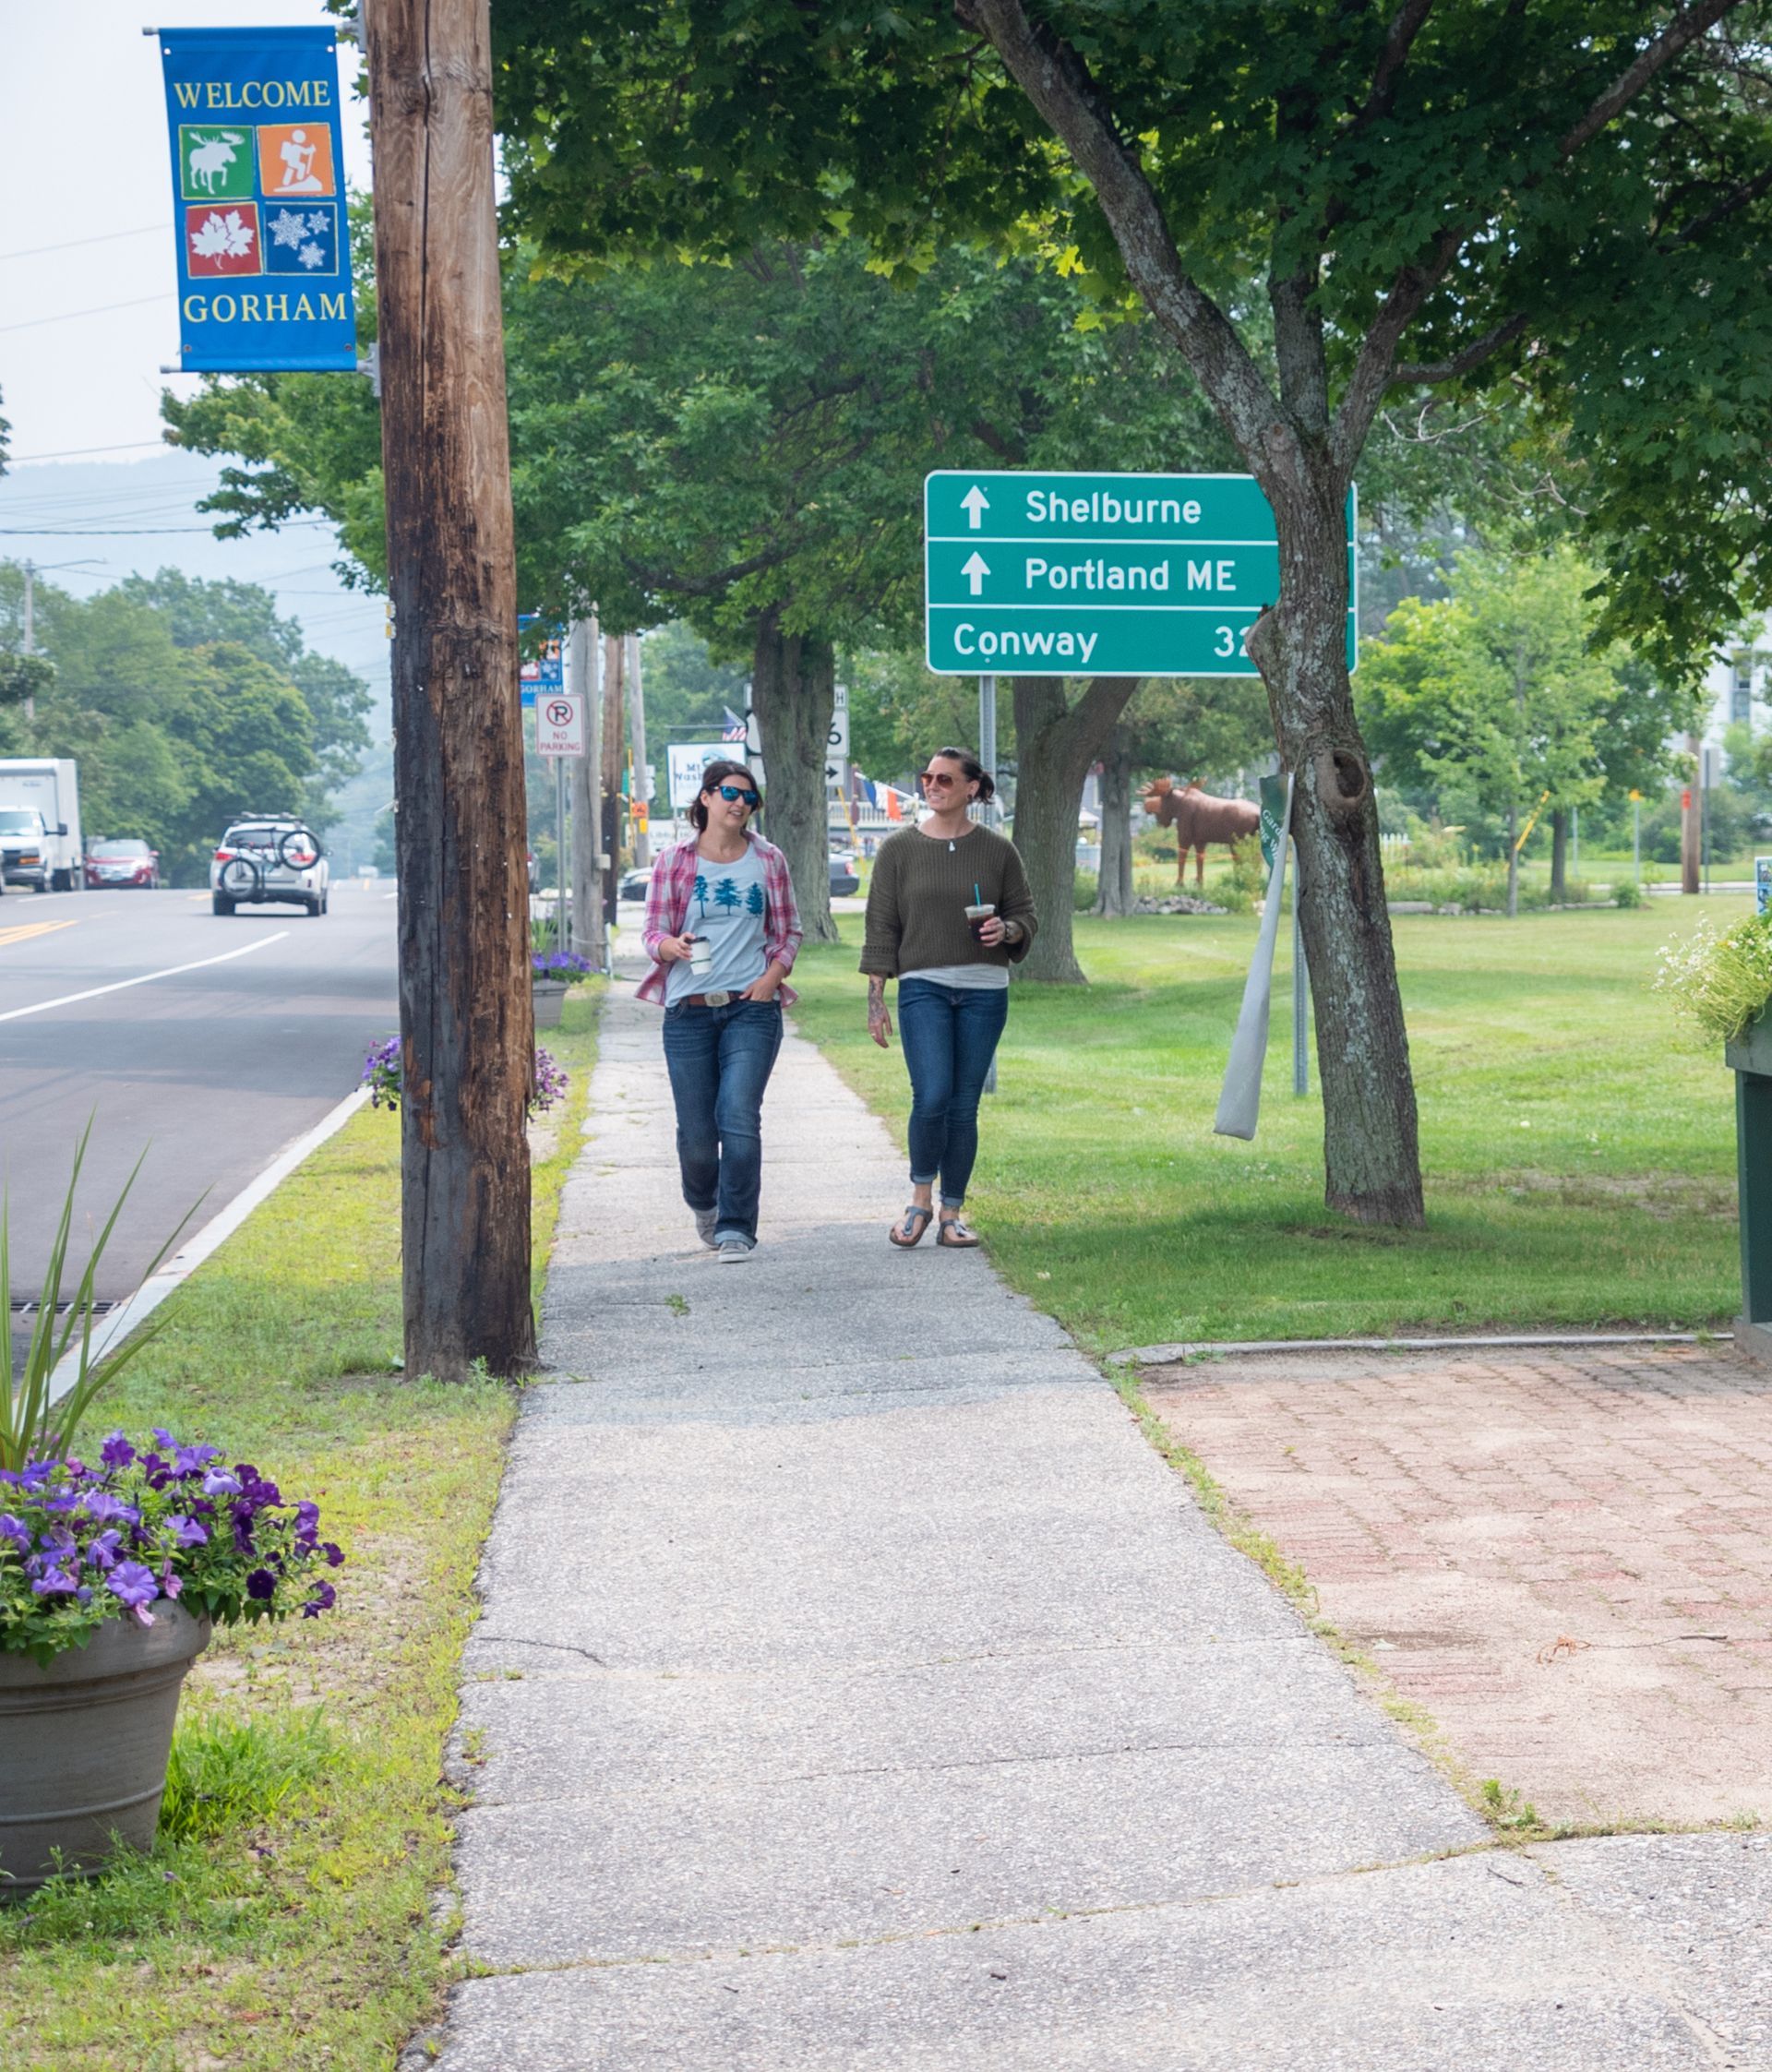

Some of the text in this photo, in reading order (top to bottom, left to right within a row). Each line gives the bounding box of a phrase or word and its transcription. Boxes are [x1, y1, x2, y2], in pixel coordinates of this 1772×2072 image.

[174, 80, 330, 109] WELCOME
[183, 293, 347, 323] GORHAM
[1025, 490, 1202, 524] Shelburne
[1025, 557, 1237, 592] Portland ME
[953, 623, 1098, 664] Conway
[540, 742, 581, 751] PARKING
[552, 731, 568, 740] NO
